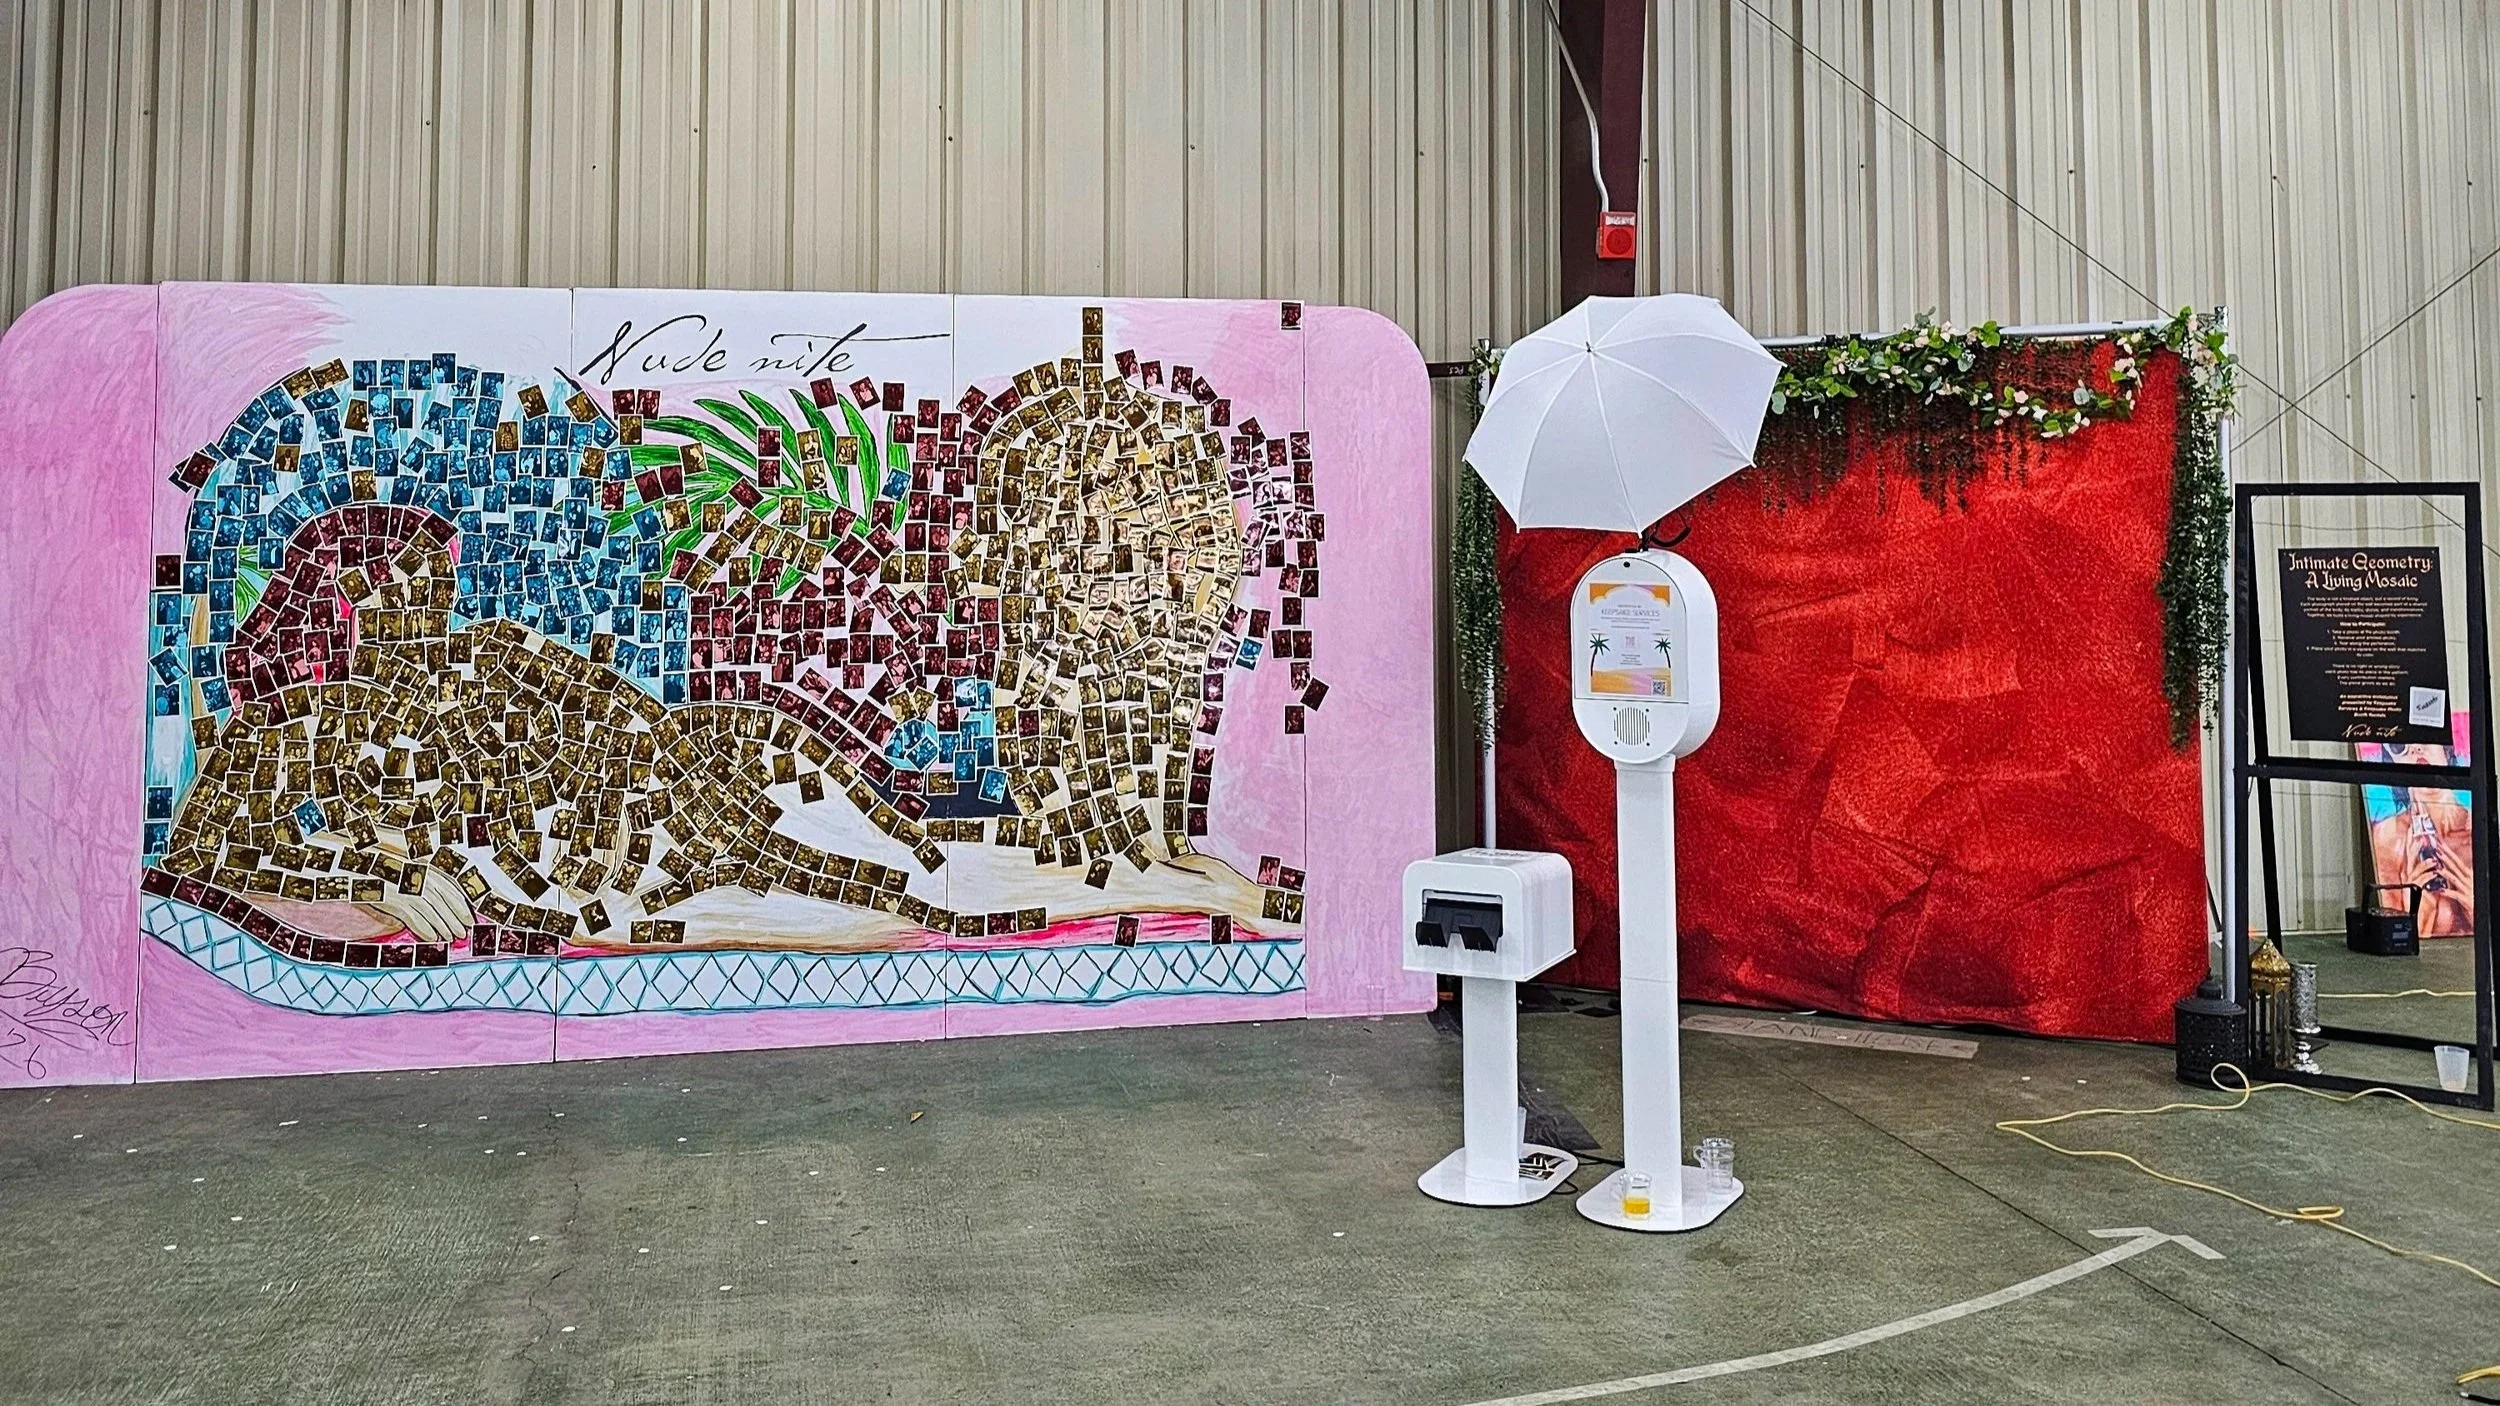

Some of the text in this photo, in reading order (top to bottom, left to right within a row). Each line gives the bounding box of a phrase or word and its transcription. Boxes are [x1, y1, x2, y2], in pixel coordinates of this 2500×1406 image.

[578, 314, 951, 384] Nude nite
[2289, 552, 2433, 573] Intimate Geometry:
[2304, 571, 2418, 592] A Living Mosaic
